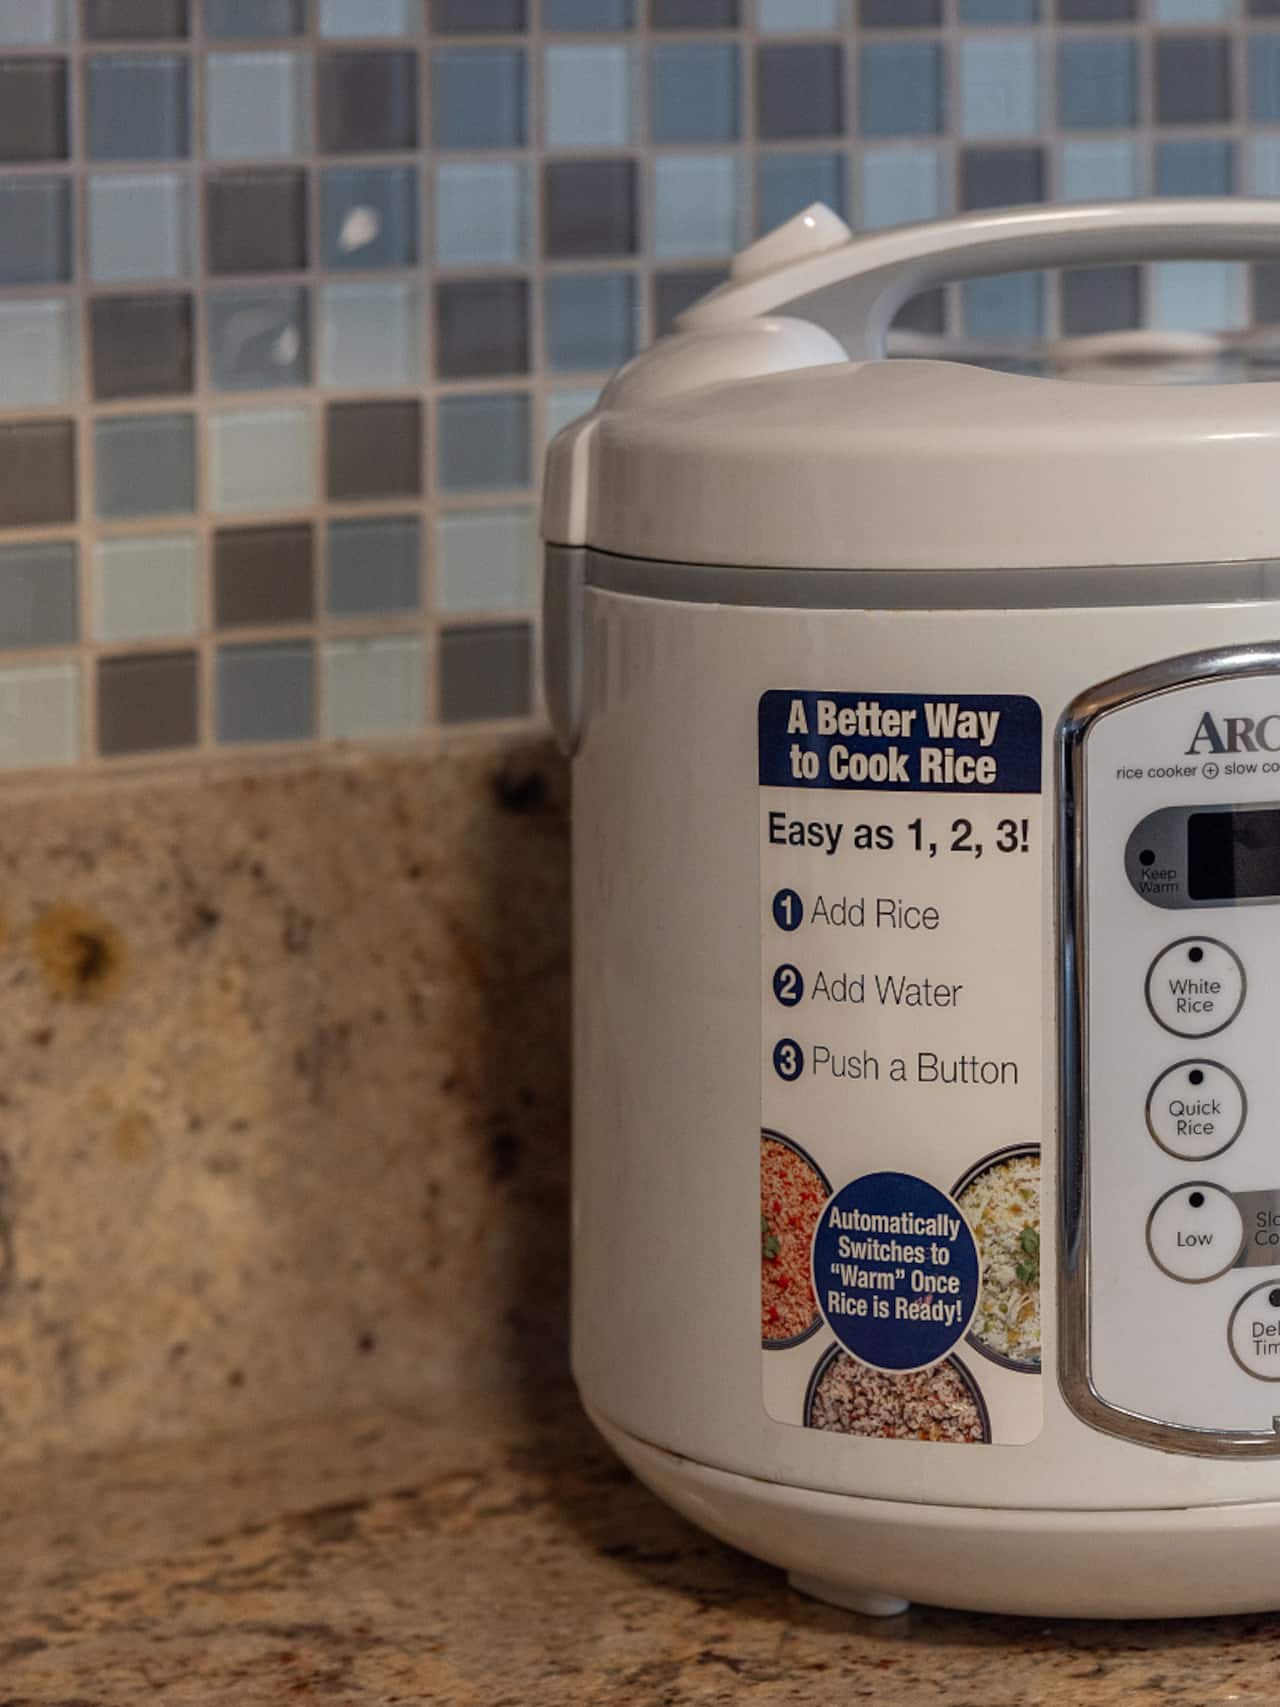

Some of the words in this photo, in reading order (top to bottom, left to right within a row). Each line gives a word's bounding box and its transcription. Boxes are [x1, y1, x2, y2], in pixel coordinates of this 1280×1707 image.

[787, 700, 808, 735] A
[817, 701, 917, 737] Better
[925, 703, 1000, 746] Way
[790, 745, 819, 779] to
[829, 746, 910, 782] Cook
[920, 748, 997, 784] Rice
[1116, 766, 1143, 780] rice
[1147, 765, 1196, 778] cooker
[1224, 762, 1257, 776] slow
[768, 812, 843, 855] Easy
[853, 821, 894, 849] as
[907, 819, 937, 857] 1,
[950, 819, 983, 858] 2,
[996, 819, 1030, 852] 3!
[1141, 868, 1177, 882] Keep
[1139, 881, 1179, 894] Warm
[780, 894, 793, 925] 1
[810, 896, 864, 927] Add
[876, 898, 940, 930] Rice
[780, 969, 797, 1000] 2
[811, 971, 864, 1003] Add
[874, 975, 963, 1007] Water
[1169, 979, 1221, 995] White
[1176, 998, 1214, 1013] Rice
[780, 1044, 797, 1076] 3
[812, 1046, 879, 1080] Push
[889, 1057, 907, 1082] a
[917, 1052, 1018, 1085] Button
[1168, 1099, 1221, 1117] Quick
[1177, 1120, 1214, 1136] Rice
[828, 1206, 960, 1241] Automatically
[838, 1236, 925, 1263] Switches
[930, 1243, 950, 1265] to
[1177, 1231, 1213, 1246] Low
[911, 1270, 960, 1294] Once
[828, 1292, 868, 1317] Rice
[872, 1295, 890, 1318] is
[895, 1297, 963, 1327] Ready!
